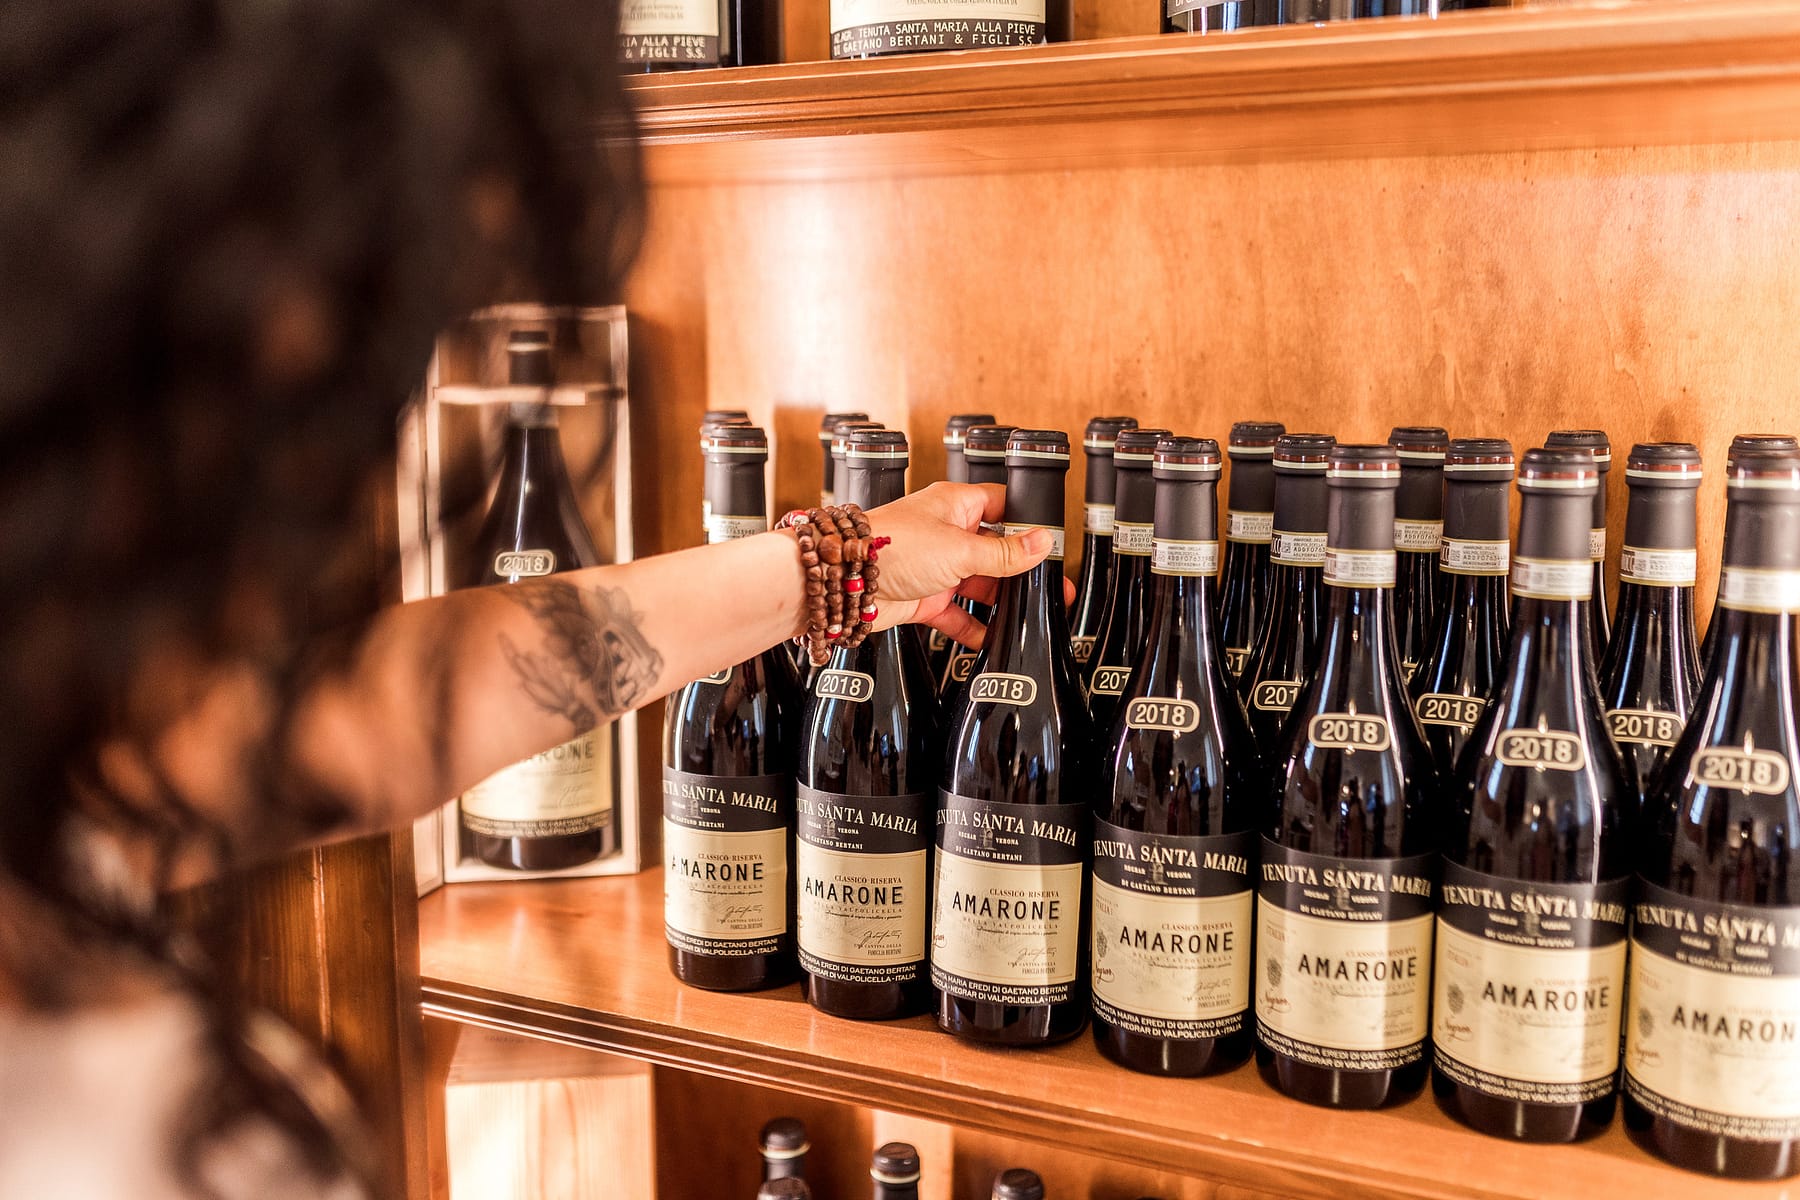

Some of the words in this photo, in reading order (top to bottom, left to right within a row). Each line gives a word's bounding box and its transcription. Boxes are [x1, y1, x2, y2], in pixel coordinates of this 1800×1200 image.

[858, 25, 891, 38] TENUTA
[895, 23, 928, 35] SANTA
[934, 21, 970, 32] MARIA
[975, 21, 1002, 33] ALLA
[1007, 23, 1036, 36] PIEVE
[642, 36, 669, 47] ALLA
[673, 36, 705, 47] PIEVE
[843, 38, 882, 53] GAETANO
[889, 34, 945, 47] BERTANI
[955, 34, 963, 45] &
[972, 34, 1011, 45] FIGLI
[625, 48, 633, 59] &
[640, 47, 677, 58] FIGLI
[685, 47, 706, 59] S.S.
[503, 556, 544, 572] 2018
[822, 674, 861, 697] 2018
[977, 677, 1024, 700] 2018
[1134, 703, 1186, 726] 2018
[1425, 699, 1479, 722] 2018
[1320, 721, 1380, 744] 2018
[1614, 716, 1672, 739] 2018
[1508, 736, 1573, 764] 2018
[1702, 758, 1773, 784] 2018
[681, 784, 726, 805] SANTA
[730, 791, 777, 813] MARIA
[817, 802, 864, 825] SANTA
[869, 811, 918, 835] MARIA
[973, 811, 1025, 835] SANTA
[1030, 820, 1077, 847] MARIA
[838, 827, 859, 835] VERONA
[995, 837, 1019, 846] VERONA
[835, 841, 863, 850] BERTANI
[963, 848, 990, 858] GAETANO
[992, 852, 1023, 862] BERTANI
[671, 855, 764, 881] AMARONE
[731, 853, 762, 862] RISERVA
[1093, 839, 1137, 861] TENUTA
[1140, 844, 1198, 868] SANTA
[1202, 851, 1249, 875] MARIA
[834, 875, 867, 884] CLASSICO
[870, 877, 902, 885] RISERVA
[1130, 881, 1161, 893] GAETANO
[1163, 885, 1197, 896] BERTANI
[1262, 863, 1319, 886] TENUTA
[1323, 868, 1385, 892] SANTA
[805, 876, 903, 906] AMARONE
[989, 887, 1025, 897] CLASSICO
[1028, 889, 1060, 898] RISERVA
[1442, 885, 1506, 910] TENUTA
[1510, 891, 1578, 918] SANTA
[952, 891, 1060, 920] AMARONE
[1636, 904, 1699, 933] TENUTA
[1703, 913, 1777, 947] SANTA
[701, 946, 754, 956] VALPOLICELLA
[757, 945, 778, 955] ITALIA
[748, 937, 778, 948] BERTANI
[1119, 925, 1234, 954] AMARONE
[821, 961, 841, 971] EREDI
[841, 965, 850, 973] DI
[850, 966, 886, 975] GAETANO
[886, 964, 917, 974] BERTANI
[837, 973, 892, 983] VALPOLICELLA
[895, 972, 917, 981] ITALIA
[1298, 954, 1417, 982] AMARONE
[968, 981, 991, 993] EREDI
[991, 985, 1001, 994] DI
[1001, 986, 1039, 996] GAETANO
[1040, 985, 1068, 995] BERTANI
[978, 992, 986, 1001] DI
[986, 994, 1045, 1004] VALPOLICELLA
[1048, 993, 1068, 1003] ITALIA
[1483, 981, 1610, 1013] AMARONE
[1117, 1009, 1140, 1024] MARIA
[1141, 1017, 1166, 1029] EREDI
[1166, 1019, 1176, 1029] DI
[1176, 1019, 1215, 1030] GAETANO
[1119, 1021, 1151, 1034] NEGRAR
[1152, 1028, 1161, 1037] DI
[1161, 1028, 1221, 1040] VALPOLICELLA
